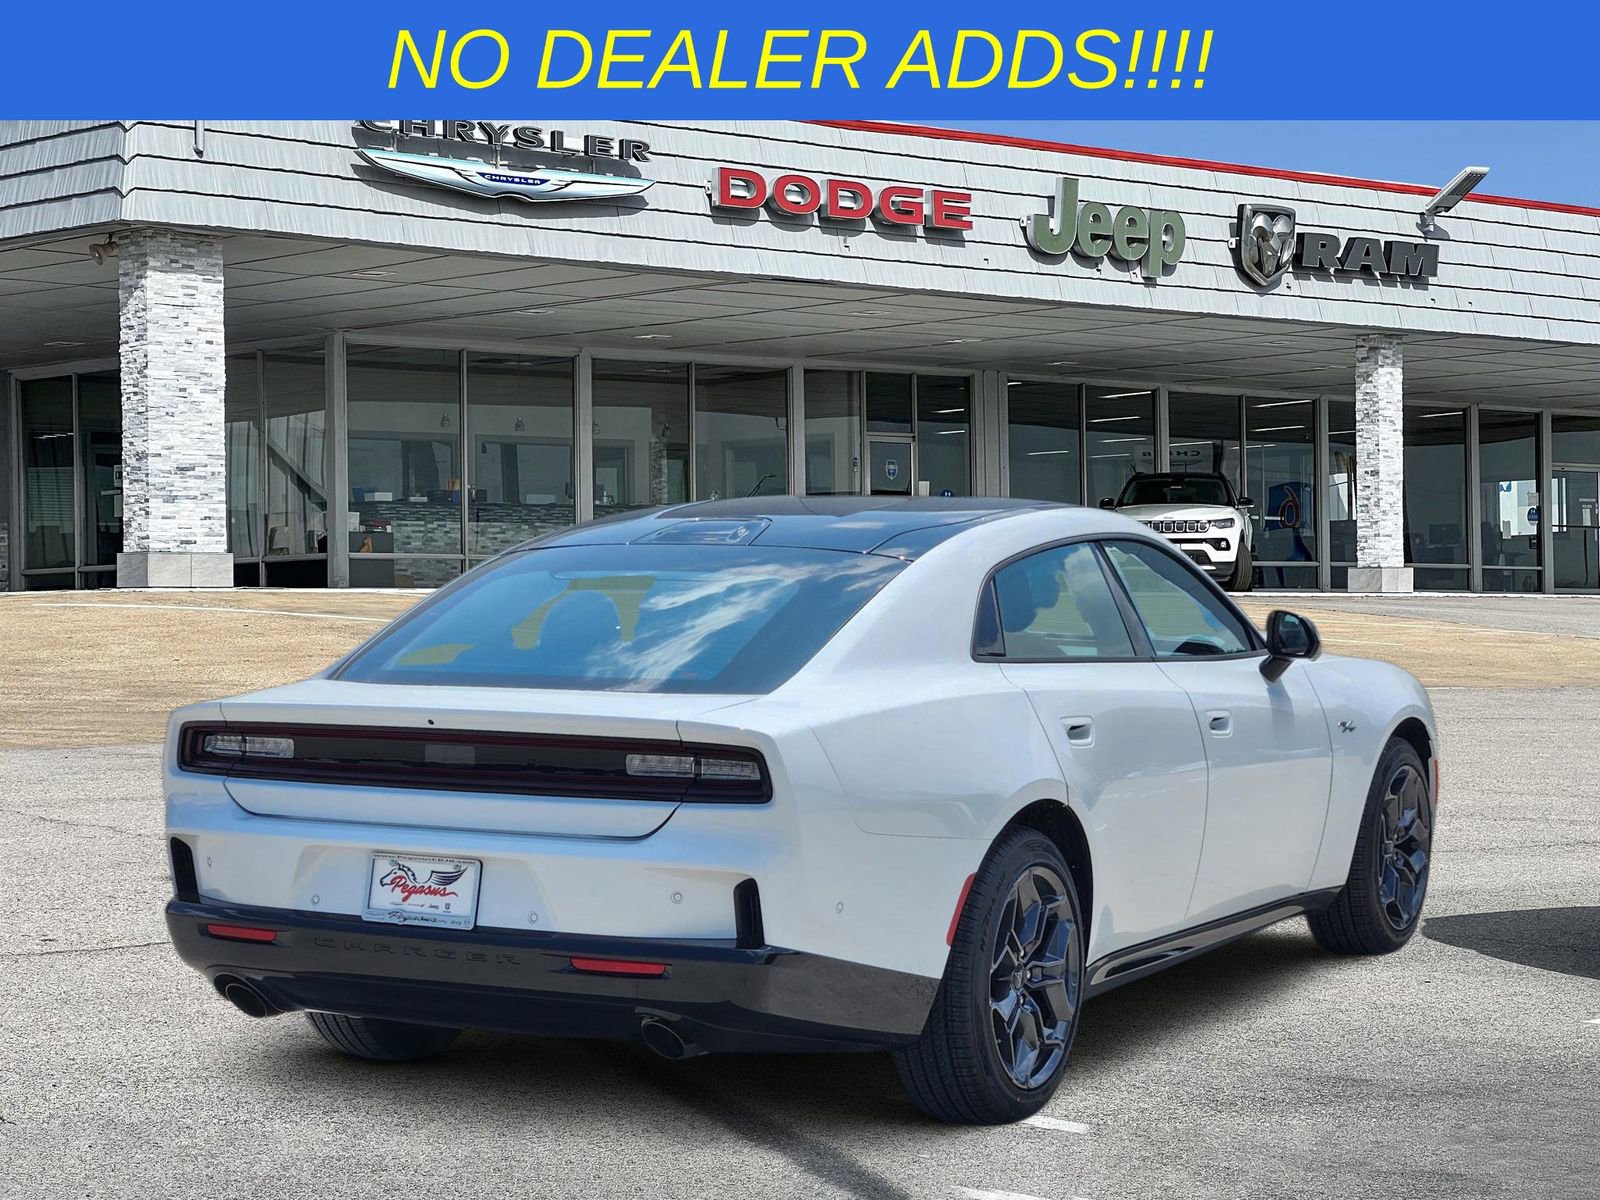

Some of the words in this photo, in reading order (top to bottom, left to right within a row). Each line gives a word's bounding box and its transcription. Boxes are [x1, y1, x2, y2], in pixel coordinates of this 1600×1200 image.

[484, 173, 542, 185] CHRYSLER
[712, 166, 974, 231] DODGE
[1026, 176, 1187, 279] Jeep
[1296, 232, 1440, 279] RAM
[390, 875, 459, 903] Pegasus
[313, 936, 522, 967] CHARGER
